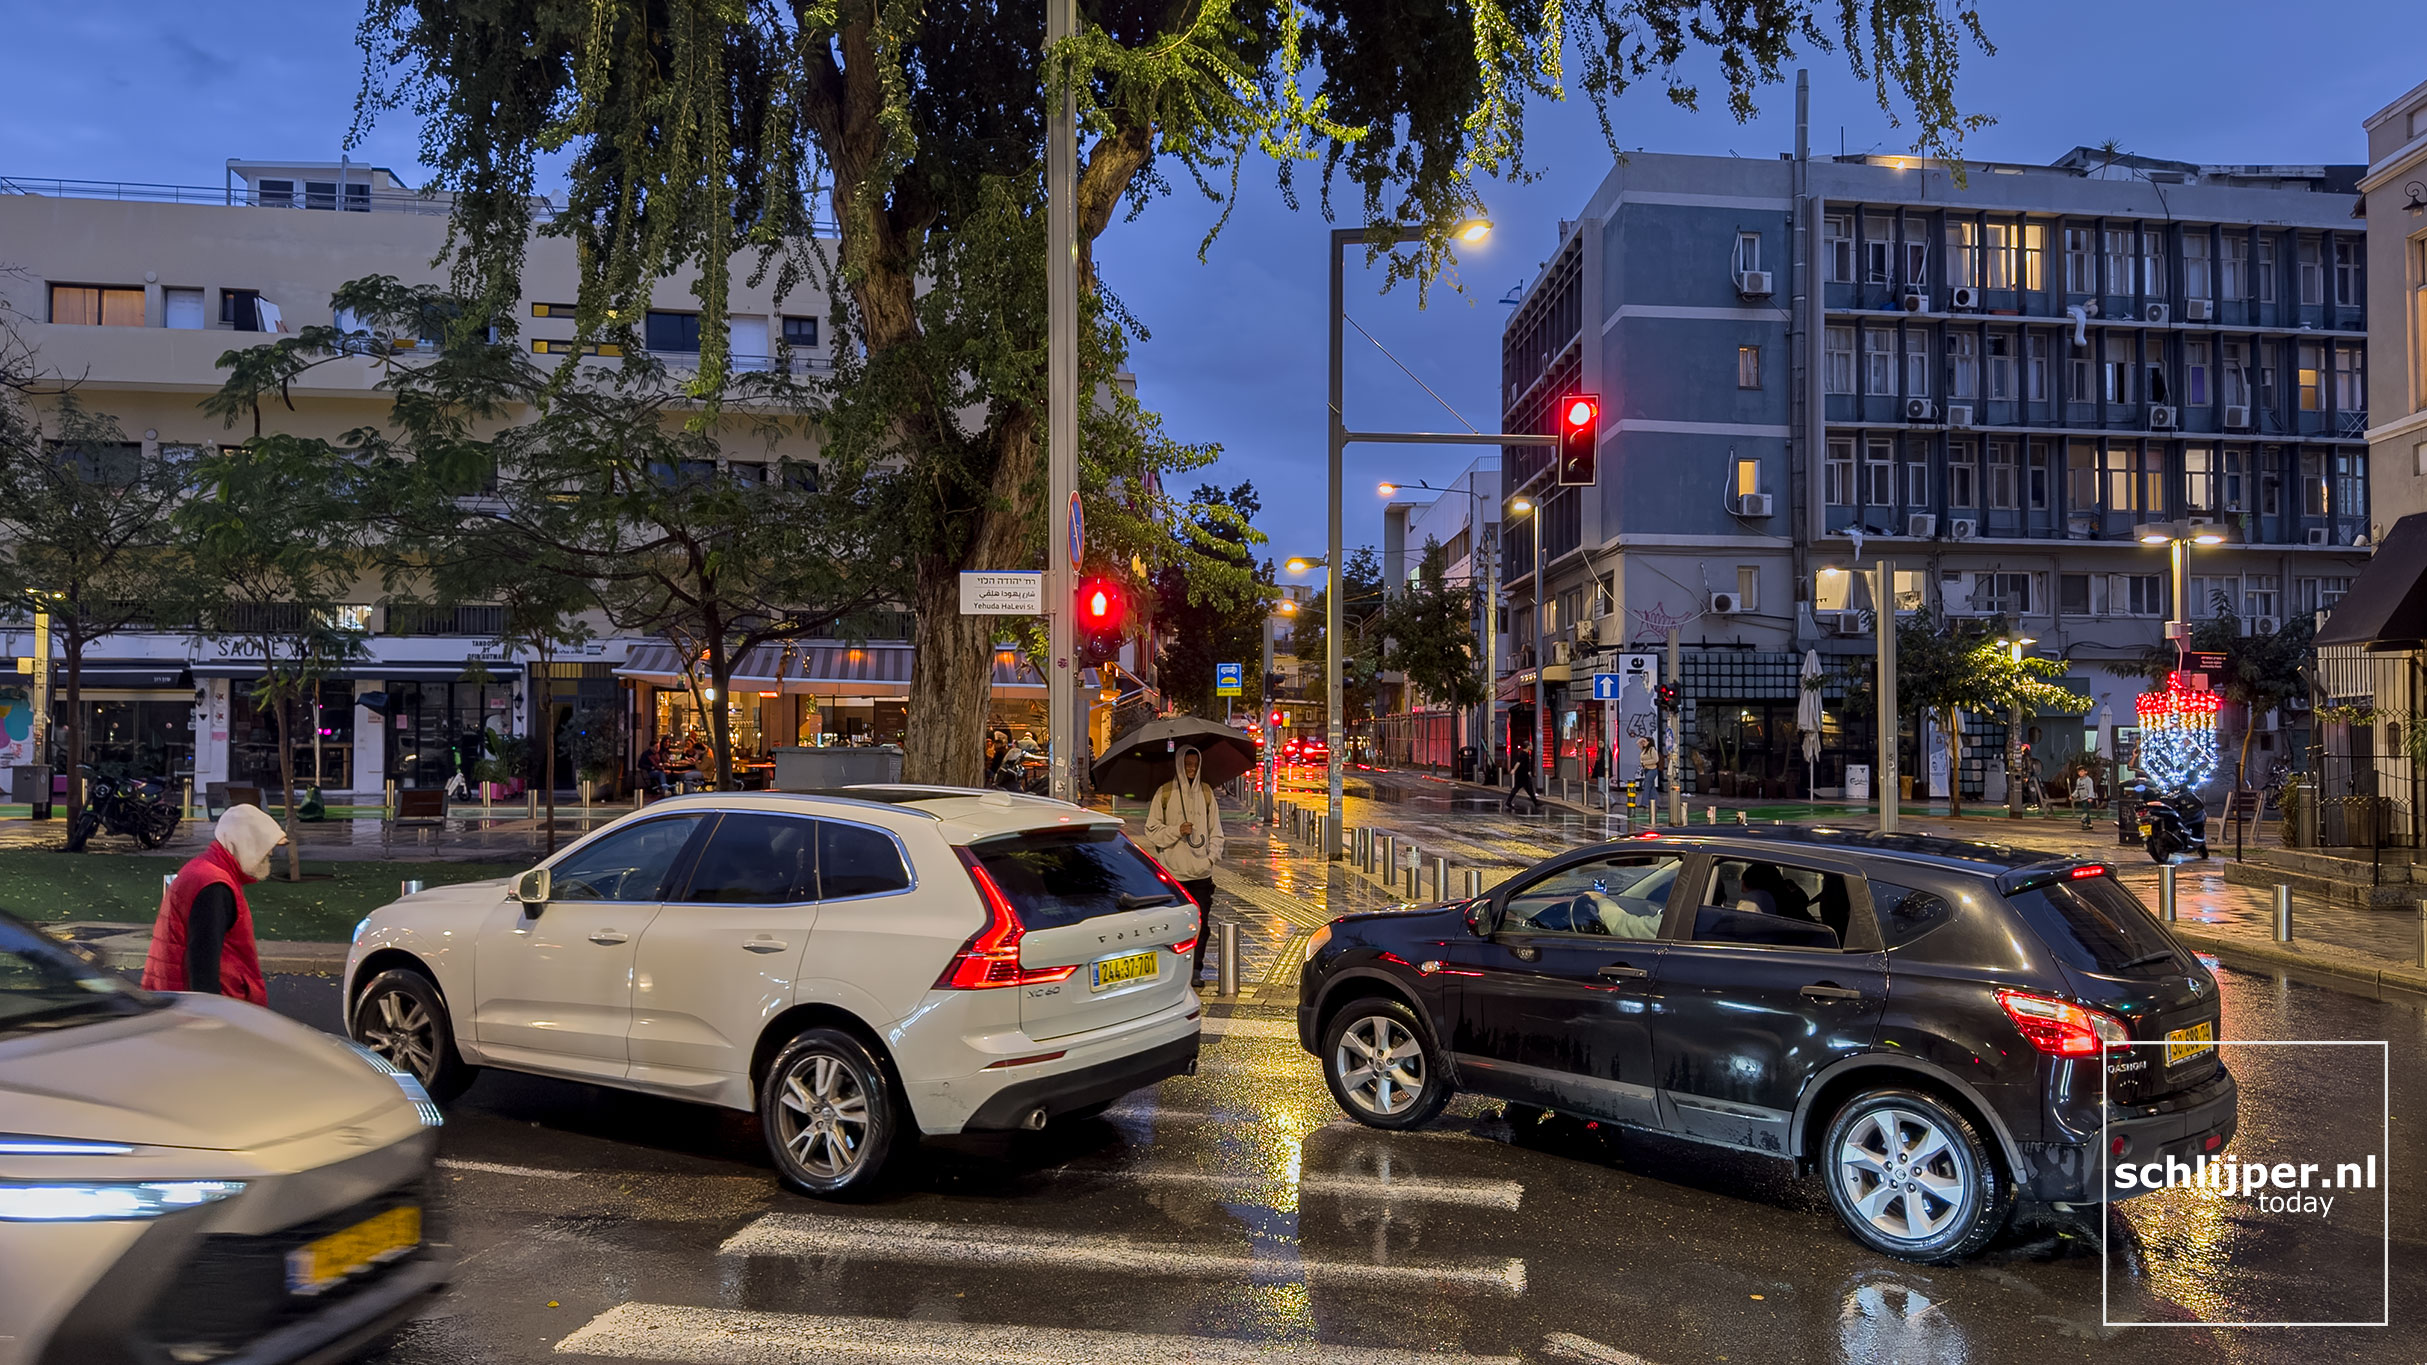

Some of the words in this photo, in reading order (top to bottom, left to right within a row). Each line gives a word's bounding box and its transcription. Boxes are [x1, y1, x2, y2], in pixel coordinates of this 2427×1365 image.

[977, 576, 995, 585] הלוי
[997, 577, 1022, 585] יהודה
[973, 602, 1000, 610] Yehuda
[1001, 602, 1026, 610] HaLevi
[1097, 923, 1169, 944] VOLVO
